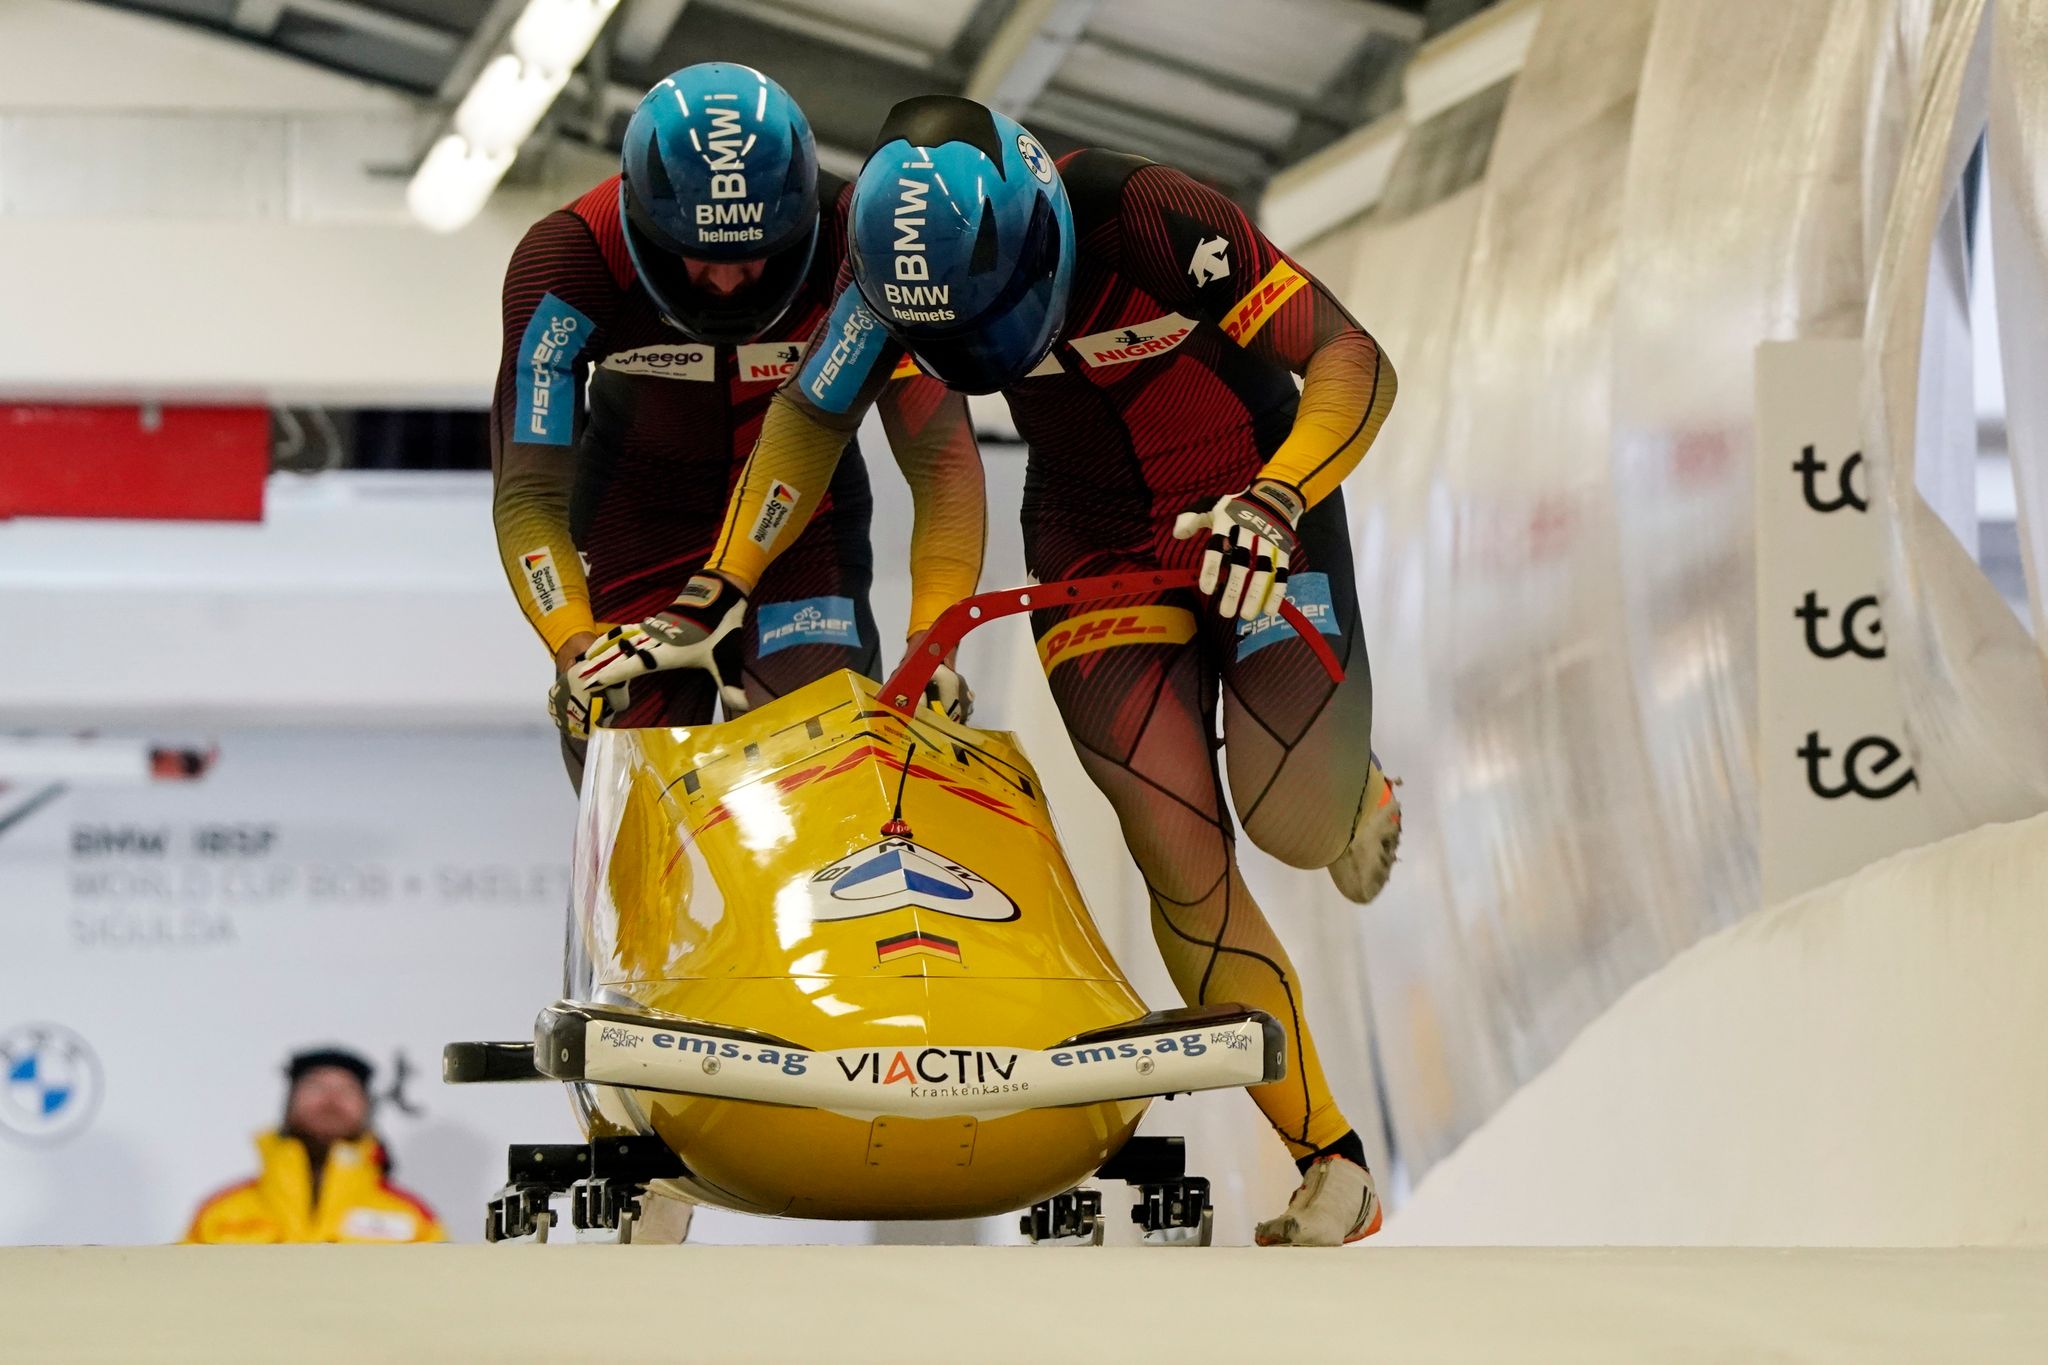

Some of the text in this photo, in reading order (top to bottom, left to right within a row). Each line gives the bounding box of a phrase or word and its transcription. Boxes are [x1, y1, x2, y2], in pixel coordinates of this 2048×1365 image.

[705, 108, 747, 199] BMW
[696, 202, 764, 225] BMW
[894, 178, 930, 281] BMW
[699, 227, 763, 242] helmets
[884, 283, 949, 306] BMW
[1225, 275, 1298, 343] DHL
[892, 306, 955, 322] helmets
[615, 352, 703, 368] wheego
[1094, 328, 1190, 363] NIGRIN
[751, 363, 796, 378] NIG
[1238, 510, 1284, 546] SEIZ
[1044, 616, 1150, 668] DHL
[1797, 731, 1918, 800] te
[612, 1039, 637, 1048] SKIN
[652, 1033, 807, 1076] ems.ag
[1050, 1033, 1207, 1067] ems.ag
[836, 1048, 1018, 1084] VIACTIV
[911, 1082, 1029, 1098] Krankenkasse
